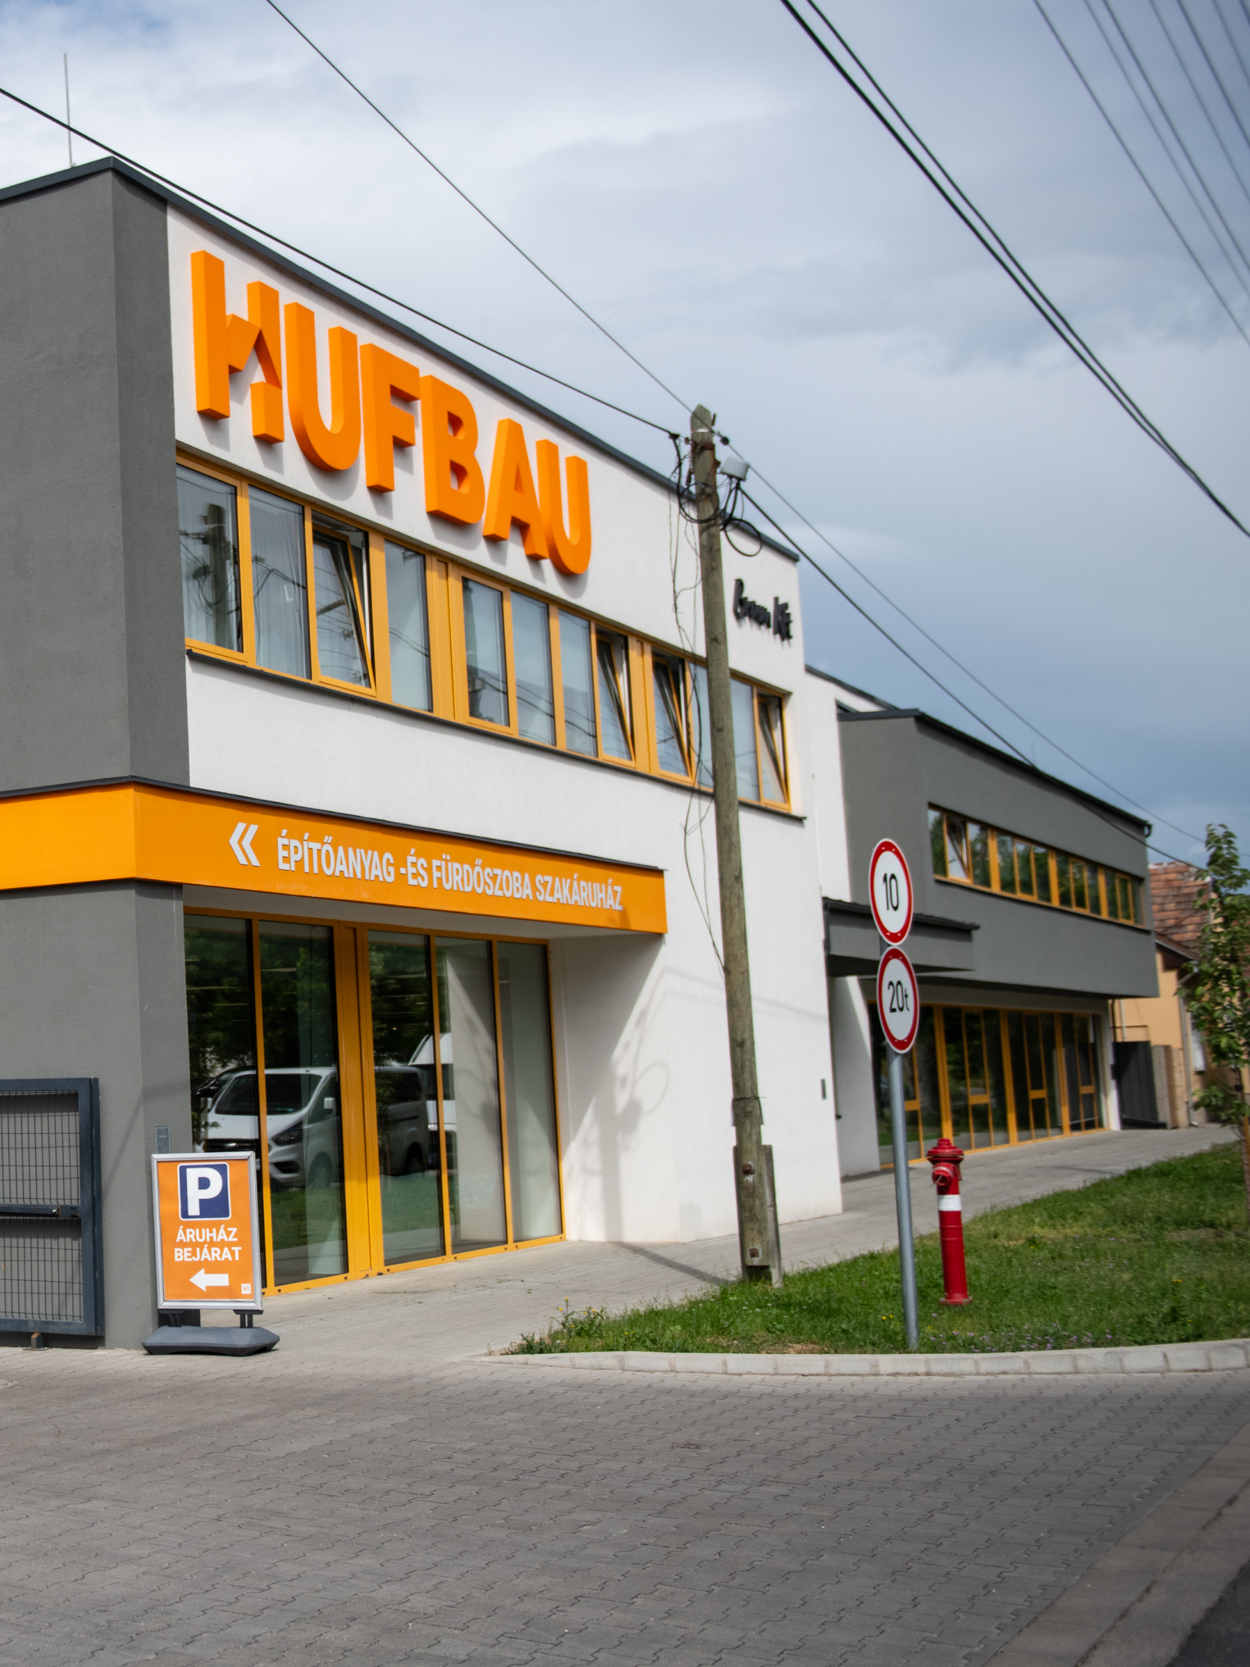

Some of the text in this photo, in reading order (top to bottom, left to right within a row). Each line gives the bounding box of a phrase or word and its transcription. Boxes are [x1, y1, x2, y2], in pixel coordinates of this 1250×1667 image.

[191, 250, 592, 576] HUFBAU
[276, 828, 624, 911] ÉPÍTŐANYAG -ÉS FÜRDŐSZOBA SZAKÁRUHÁZ
[882, 872, 900, 912] 10
[186, 1167, 223, 1216] P
[174, 1244, 242, 1262] BEJÁRAT
[176, 1224, 238, 1243] ÁRUHÁZ
